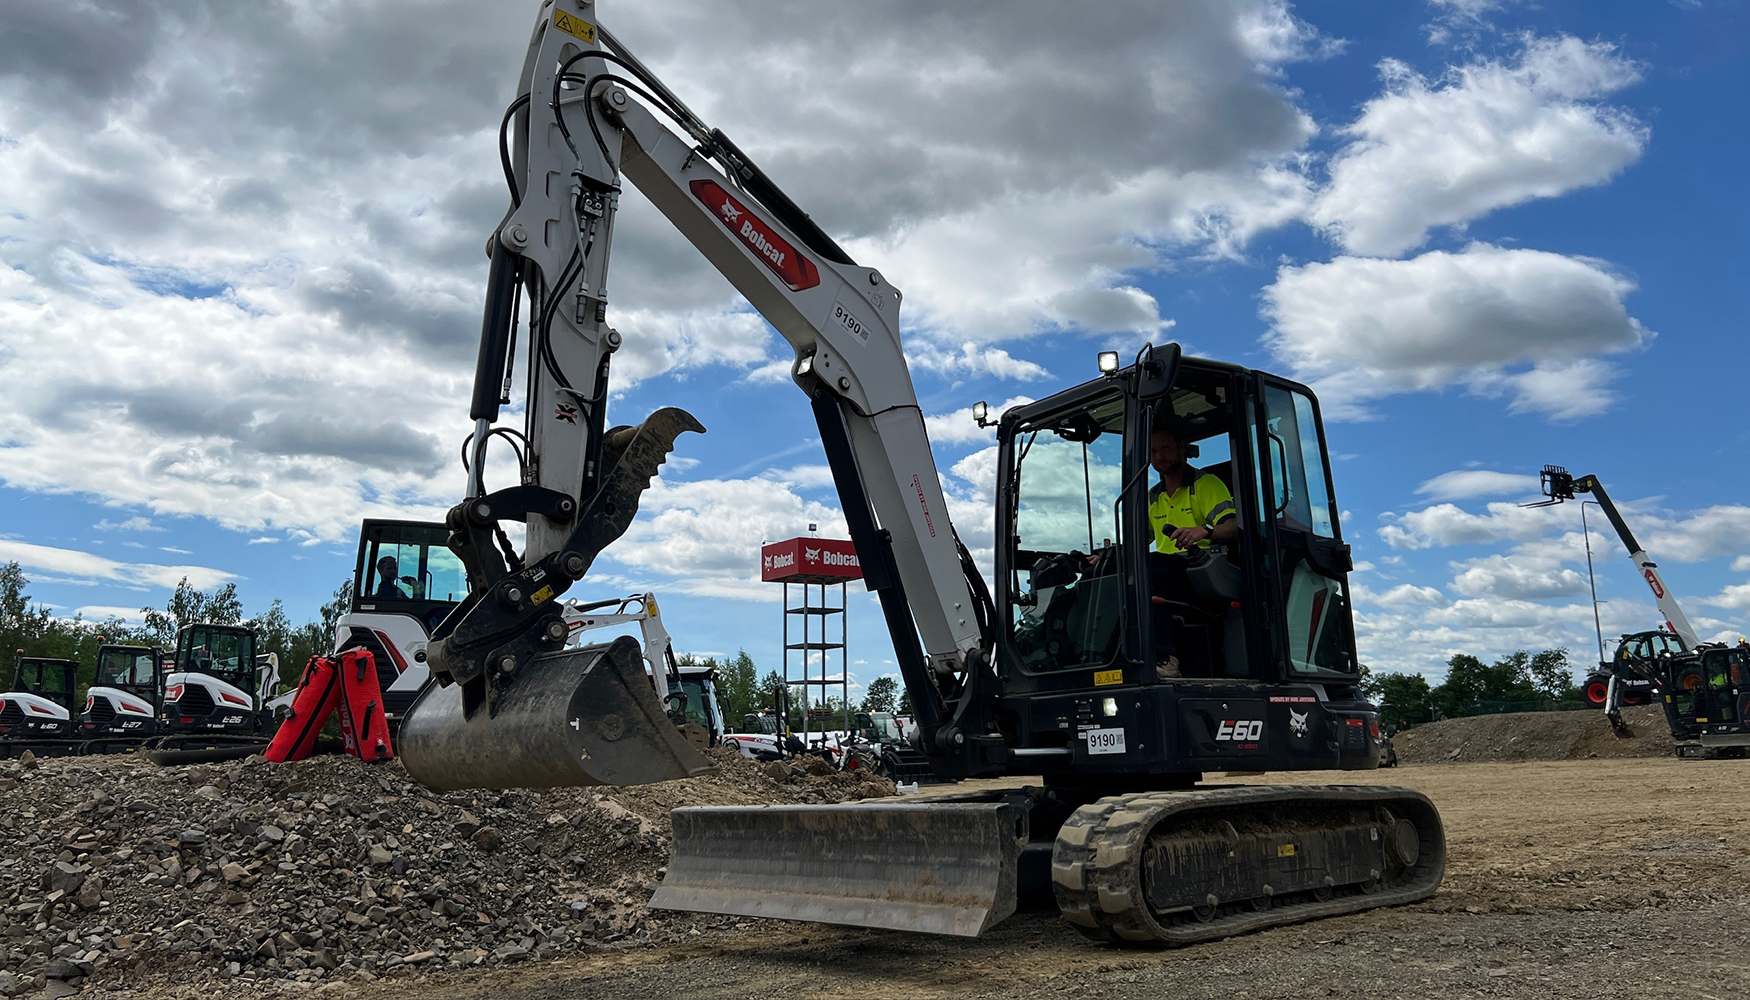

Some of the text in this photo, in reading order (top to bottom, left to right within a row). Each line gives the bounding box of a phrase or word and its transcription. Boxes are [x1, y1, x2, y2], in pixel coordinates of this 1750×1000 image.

[740, 220, 785, 268] Bobcat
[835, 306, 861, 334] 9190
[773, 551, 794, 569] Bobcat
[1215, 720, 1263, 740] E60
[1090, 733, 1115, 748] 9190
